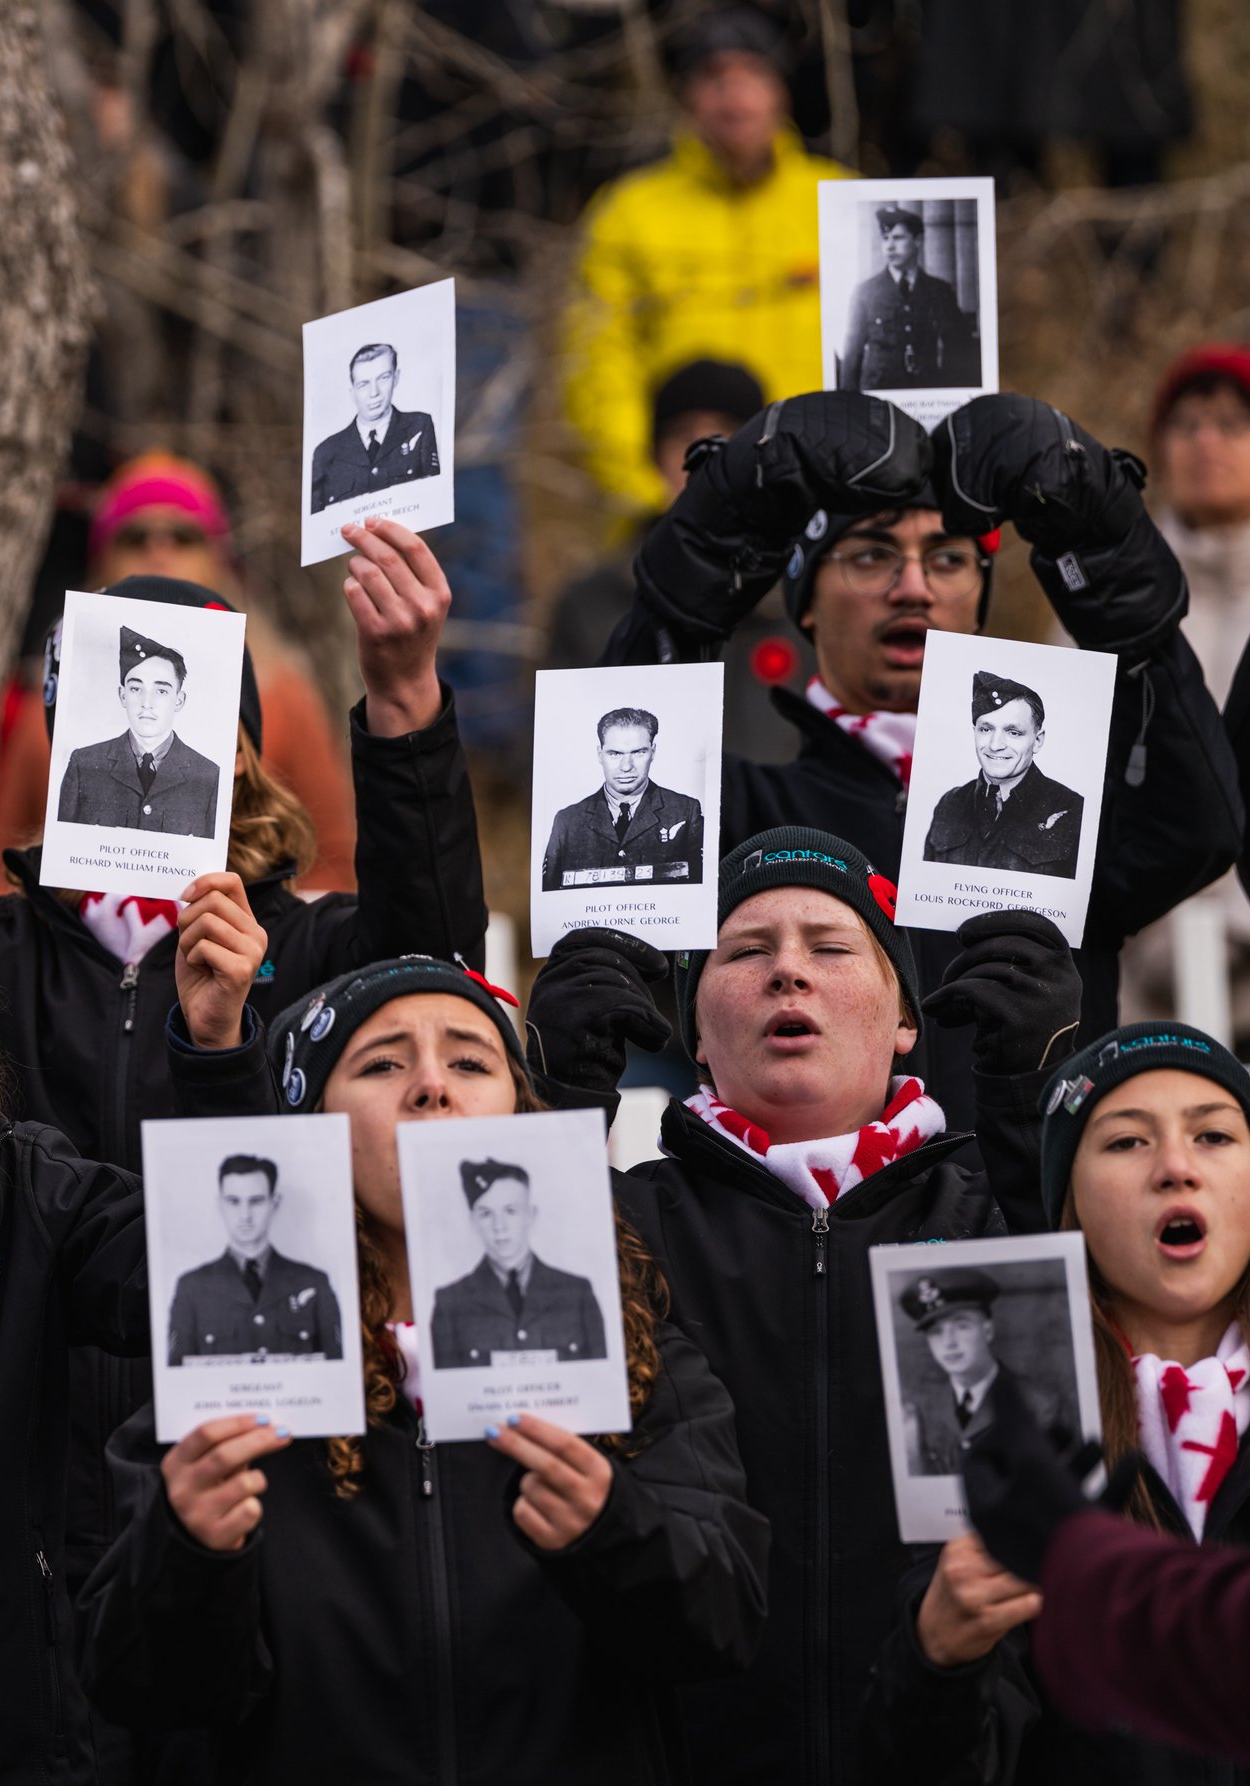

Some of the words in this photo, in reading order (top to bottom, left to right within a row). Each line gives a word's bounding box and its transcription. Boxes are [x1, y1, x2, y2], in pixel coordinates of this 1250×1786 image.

[353, 498, 393, 515] SERGEANT
[392, 503, 420, 516] BEECH
[99, 845, 126, 855] PILOT
[129, 847, 170, 860] OFFICER
[69, 856, 111, 868] RICHARD
[114, 860, 154, 873] WILLIAM
[157, 865, 197, 877] FRANCIS
[954, 882, 989, 894] FLYING
[992, 887, 1033, 899] OFFICER
[585, 904, 612, 913] PILOT
[616, 902, 656, 912] OFFICER
[914, 893, 944, 904] LOUIS
[947, 896, 1003, 910] ROCKFORD
[1007, 904, 1067, 919] GEORGESON
[561, 919, 600, 929] ANDREW
[604, 917, 636, 926] LORNE
[640, 916, 681, 925] GEORGE
[228, 1382, 284, 1393] SERGEANT
[516, 1381, 561, 1393] OFFICER
